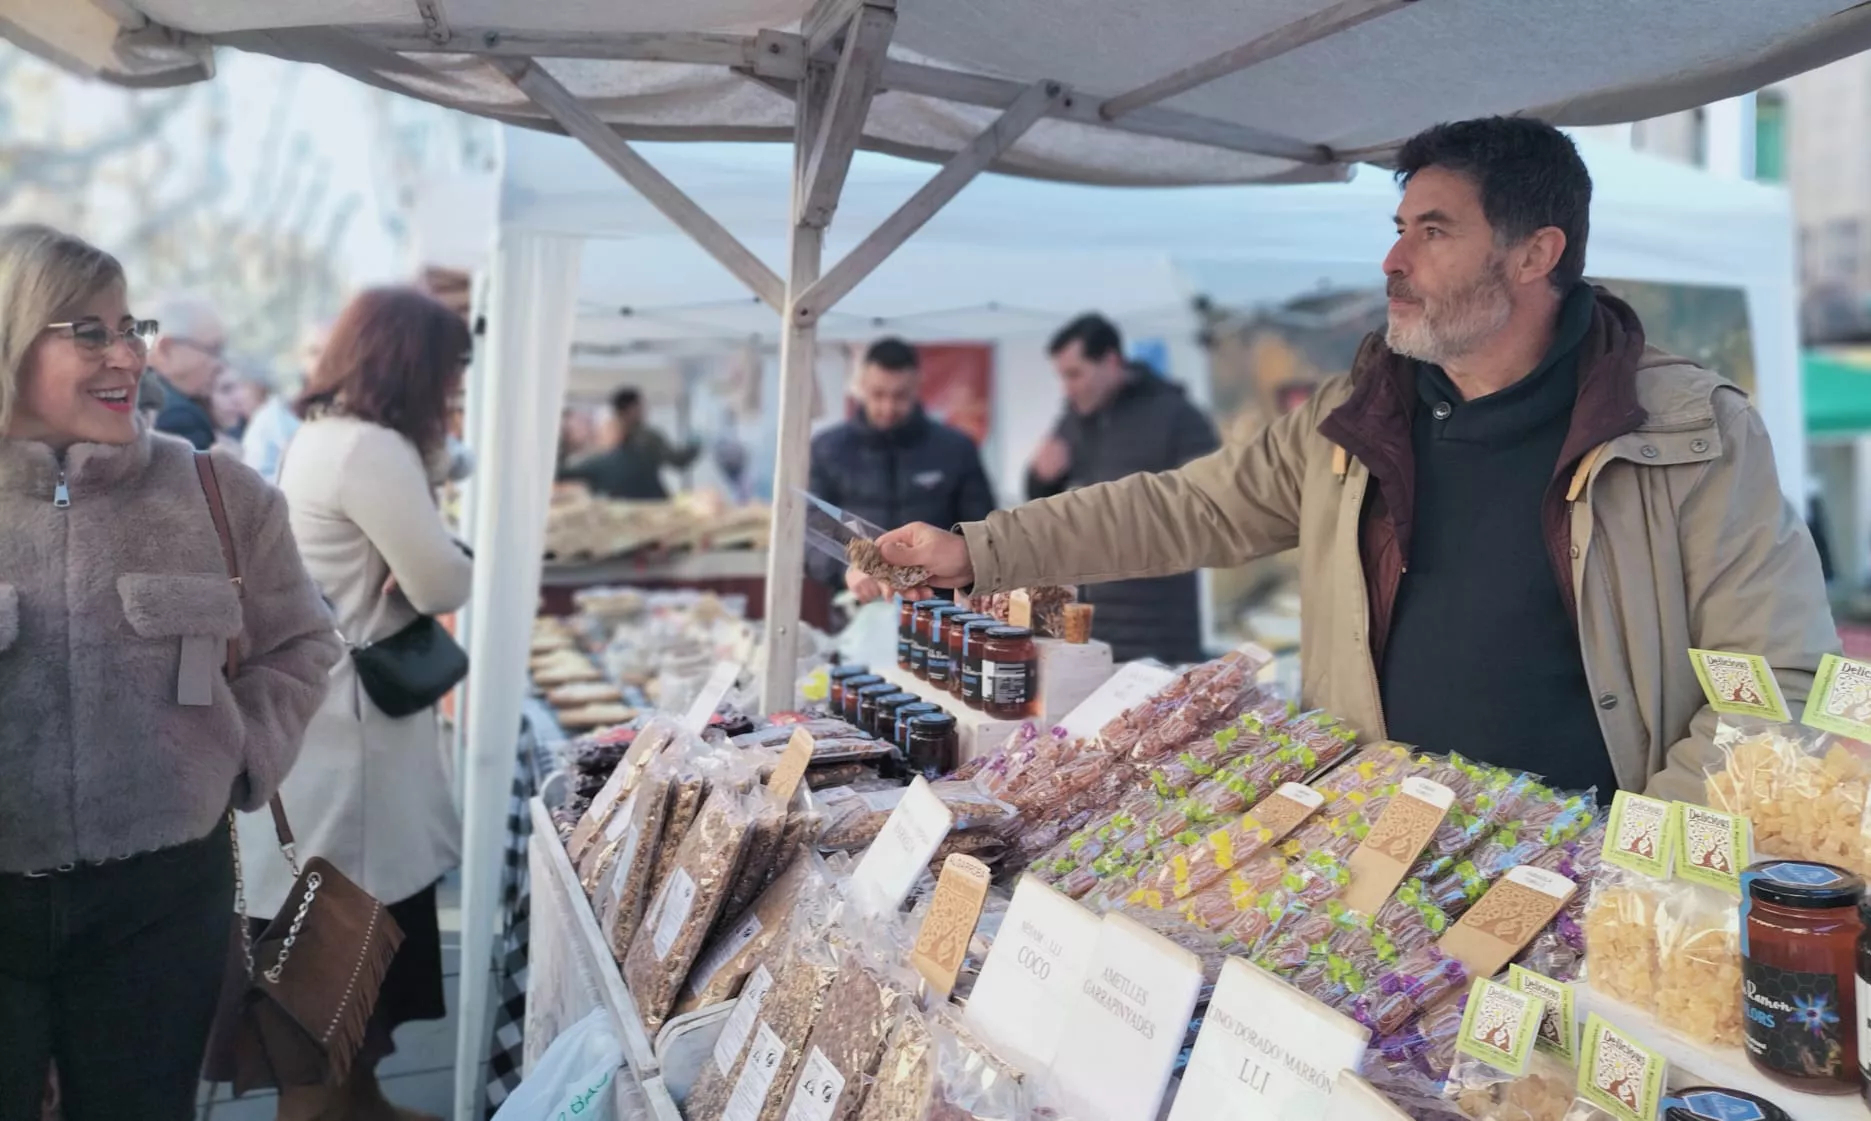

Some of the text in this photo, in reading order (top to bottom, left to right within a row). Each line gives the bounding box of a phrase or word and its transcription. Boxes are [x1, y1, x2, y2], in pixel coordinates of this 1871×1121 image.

[1707, 655, 1750, 670] Delicious
[1689, 808, 1730, 829] Delicious
[1017, 945, 1051, 980] COCO
[1103, 966, 1149, 1007] AMETLLES
[1487, 985, 1523, 1008] Delicious
[1524, 975, 1560, 1000] Delicious
[1083, 978, 1157, 1040] GARRAPINYADES
[1604, 1029, 1646, 1066] Delicious
